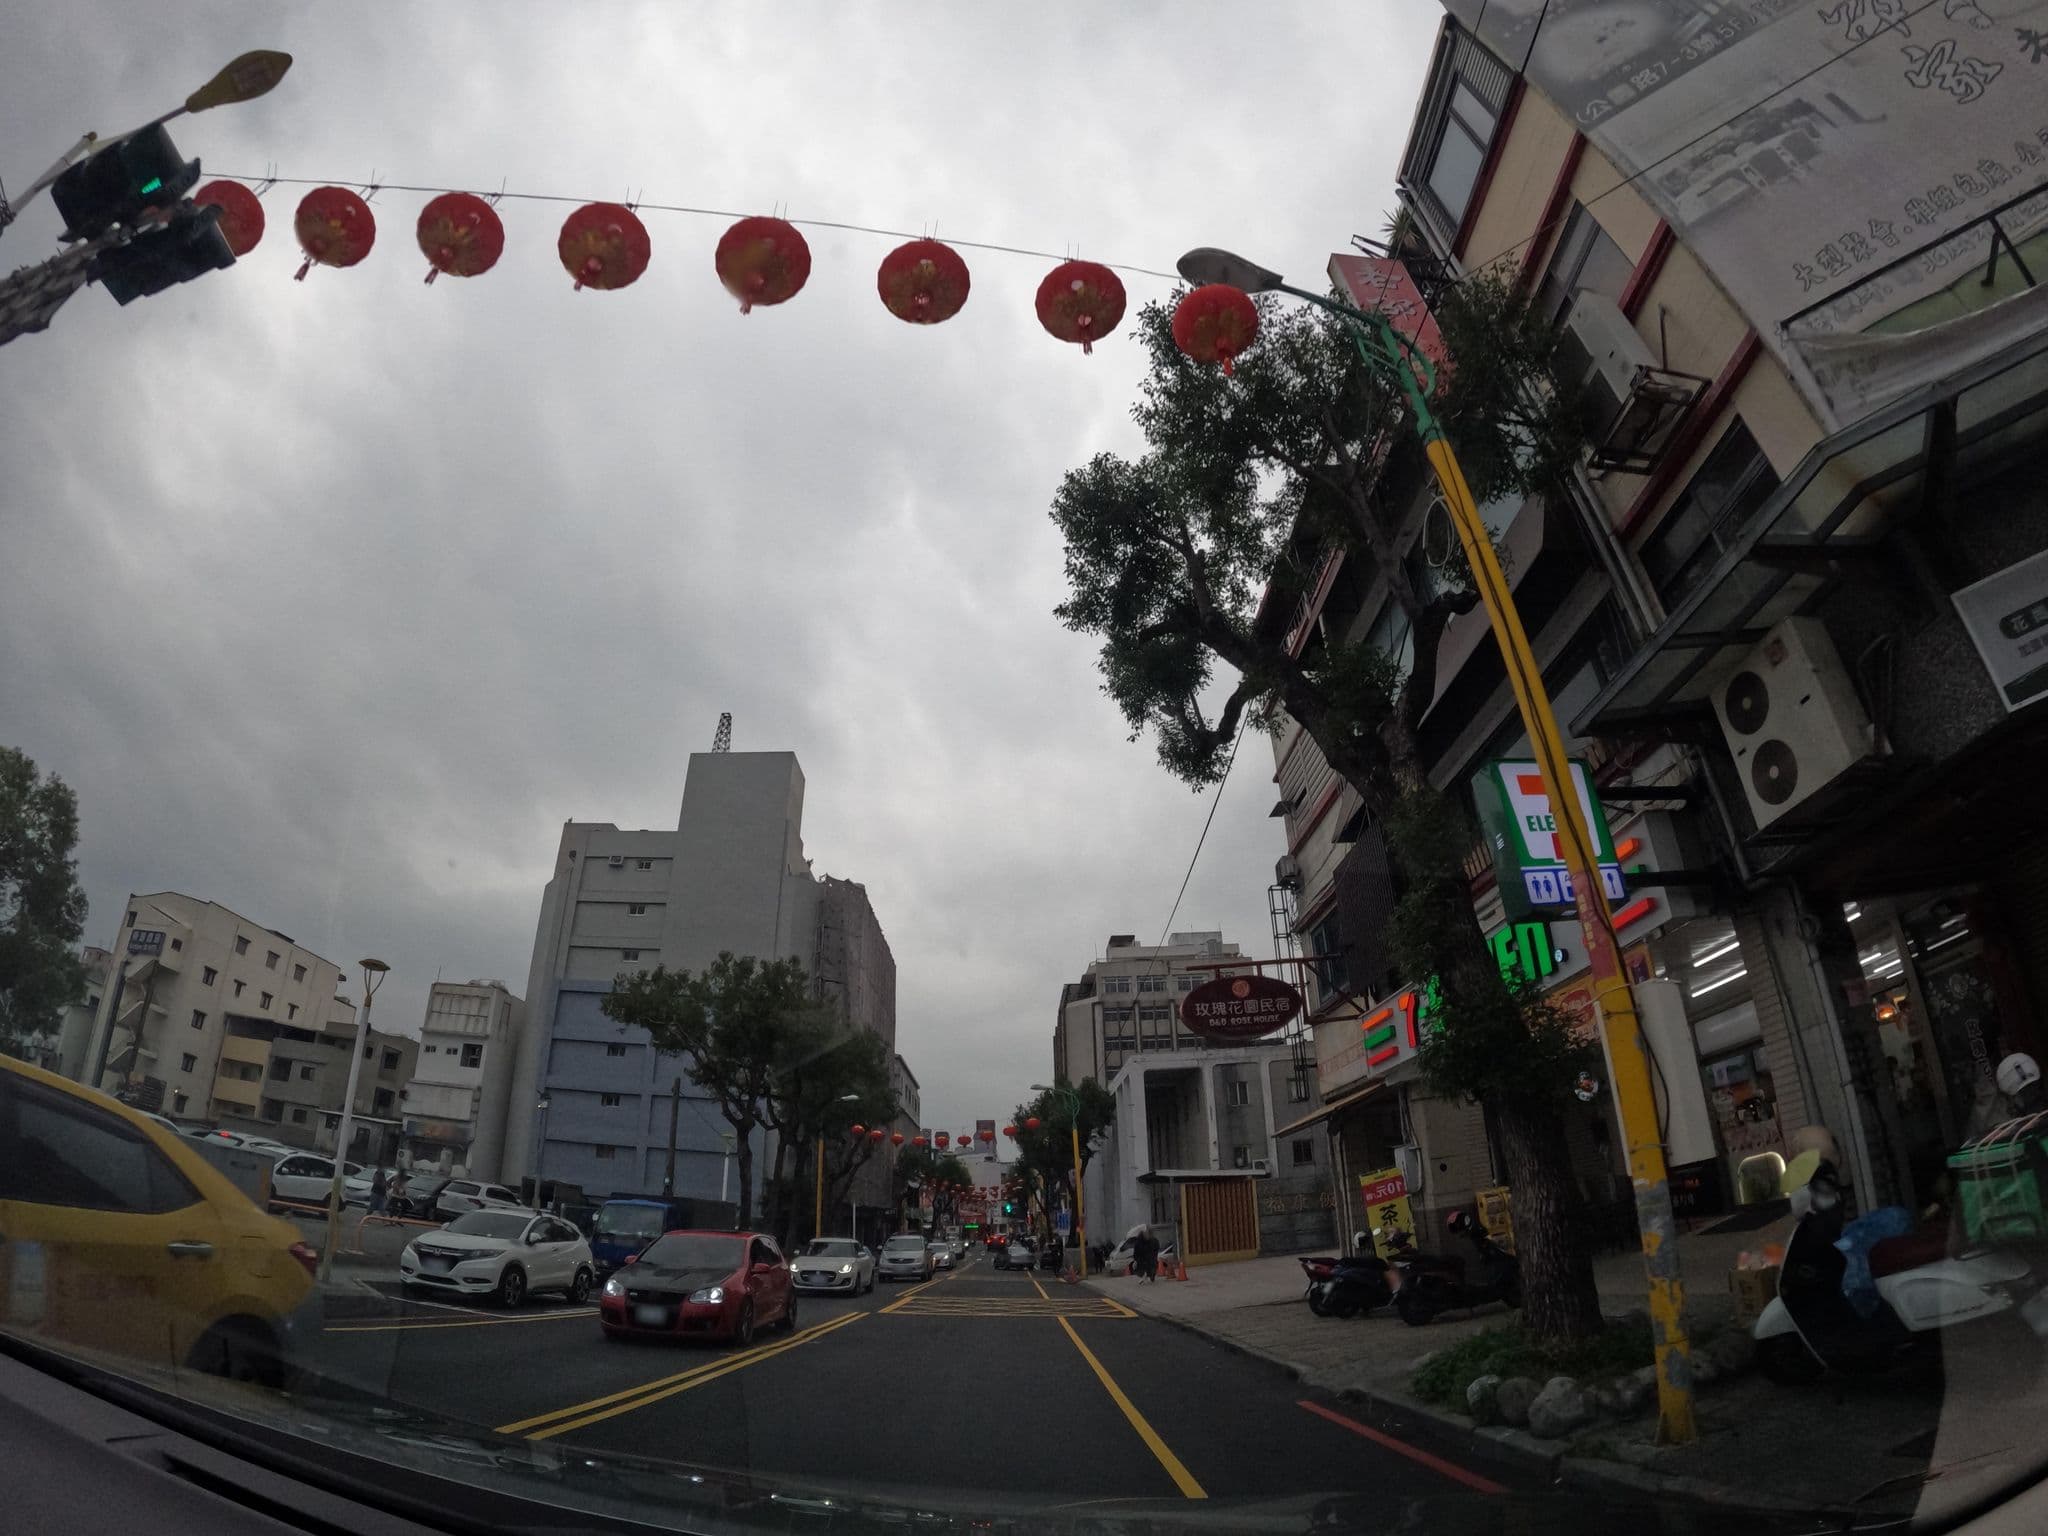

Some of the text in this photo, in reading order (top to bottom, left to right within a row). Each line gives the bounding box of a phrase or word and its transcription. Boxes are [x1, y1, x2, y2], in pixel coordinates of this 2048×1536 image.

[1194, 998, 1290, 1017] 玫瑰花園民宿
[1231, 1016, 1252, 1025] ROSE
[1253, 1014, 1280, 1023] HOUSE
